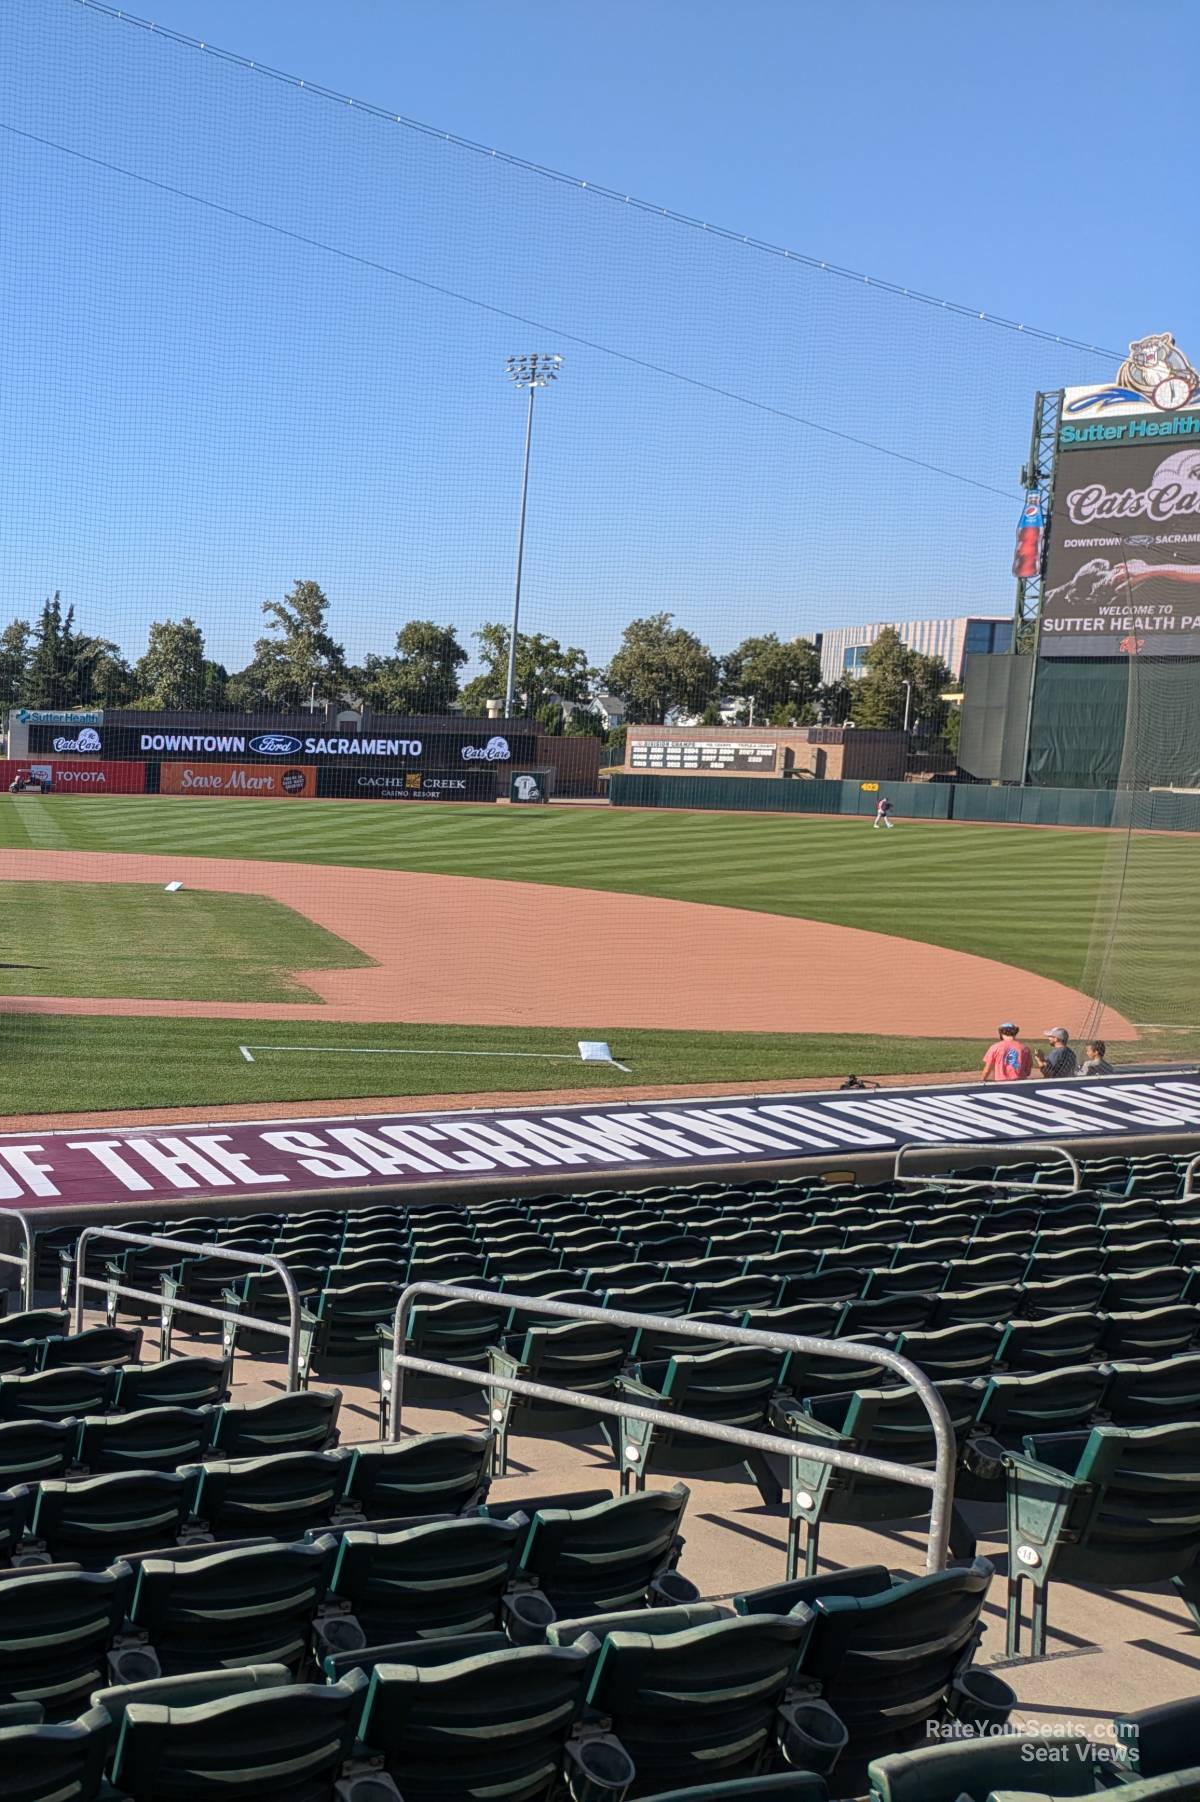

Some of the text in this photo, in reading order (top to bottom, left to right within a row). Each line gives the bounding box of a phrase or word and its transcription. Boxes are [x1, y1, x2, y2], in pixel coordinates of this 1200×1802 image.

[1060, 416, 1200, 442] Sutter Health
[1069, 486, 1145, 522] Cats
[1064, 537, 1122, 548] DOWNTOWN
[1099, 604, 1174, 615] WELCOME TO
[1042, 618, 1105, 631] SUTTER
[1110, 616, 1175, 631] HEALTH
[31, 712, 98, 724] Sutter Health
[55, 738, 101, 751] Cats Care
[140, 735, 422, 756] DOWNTOWN Ford SACRAMENTO
[463, 747, 509, 760] Cats Care
[56, 771, 106, 782] TOYOTA
[182, 769, 222, 788] Save
[224, 770, 275, 790] Mart
[357, 776, 466, 789] CACHE CREEK
[67, 1133, 291, 1192] THE
[258, 1104, 896, 1178] SACRAMENTO
[818, 1092, 1129, 1141] RIVER
